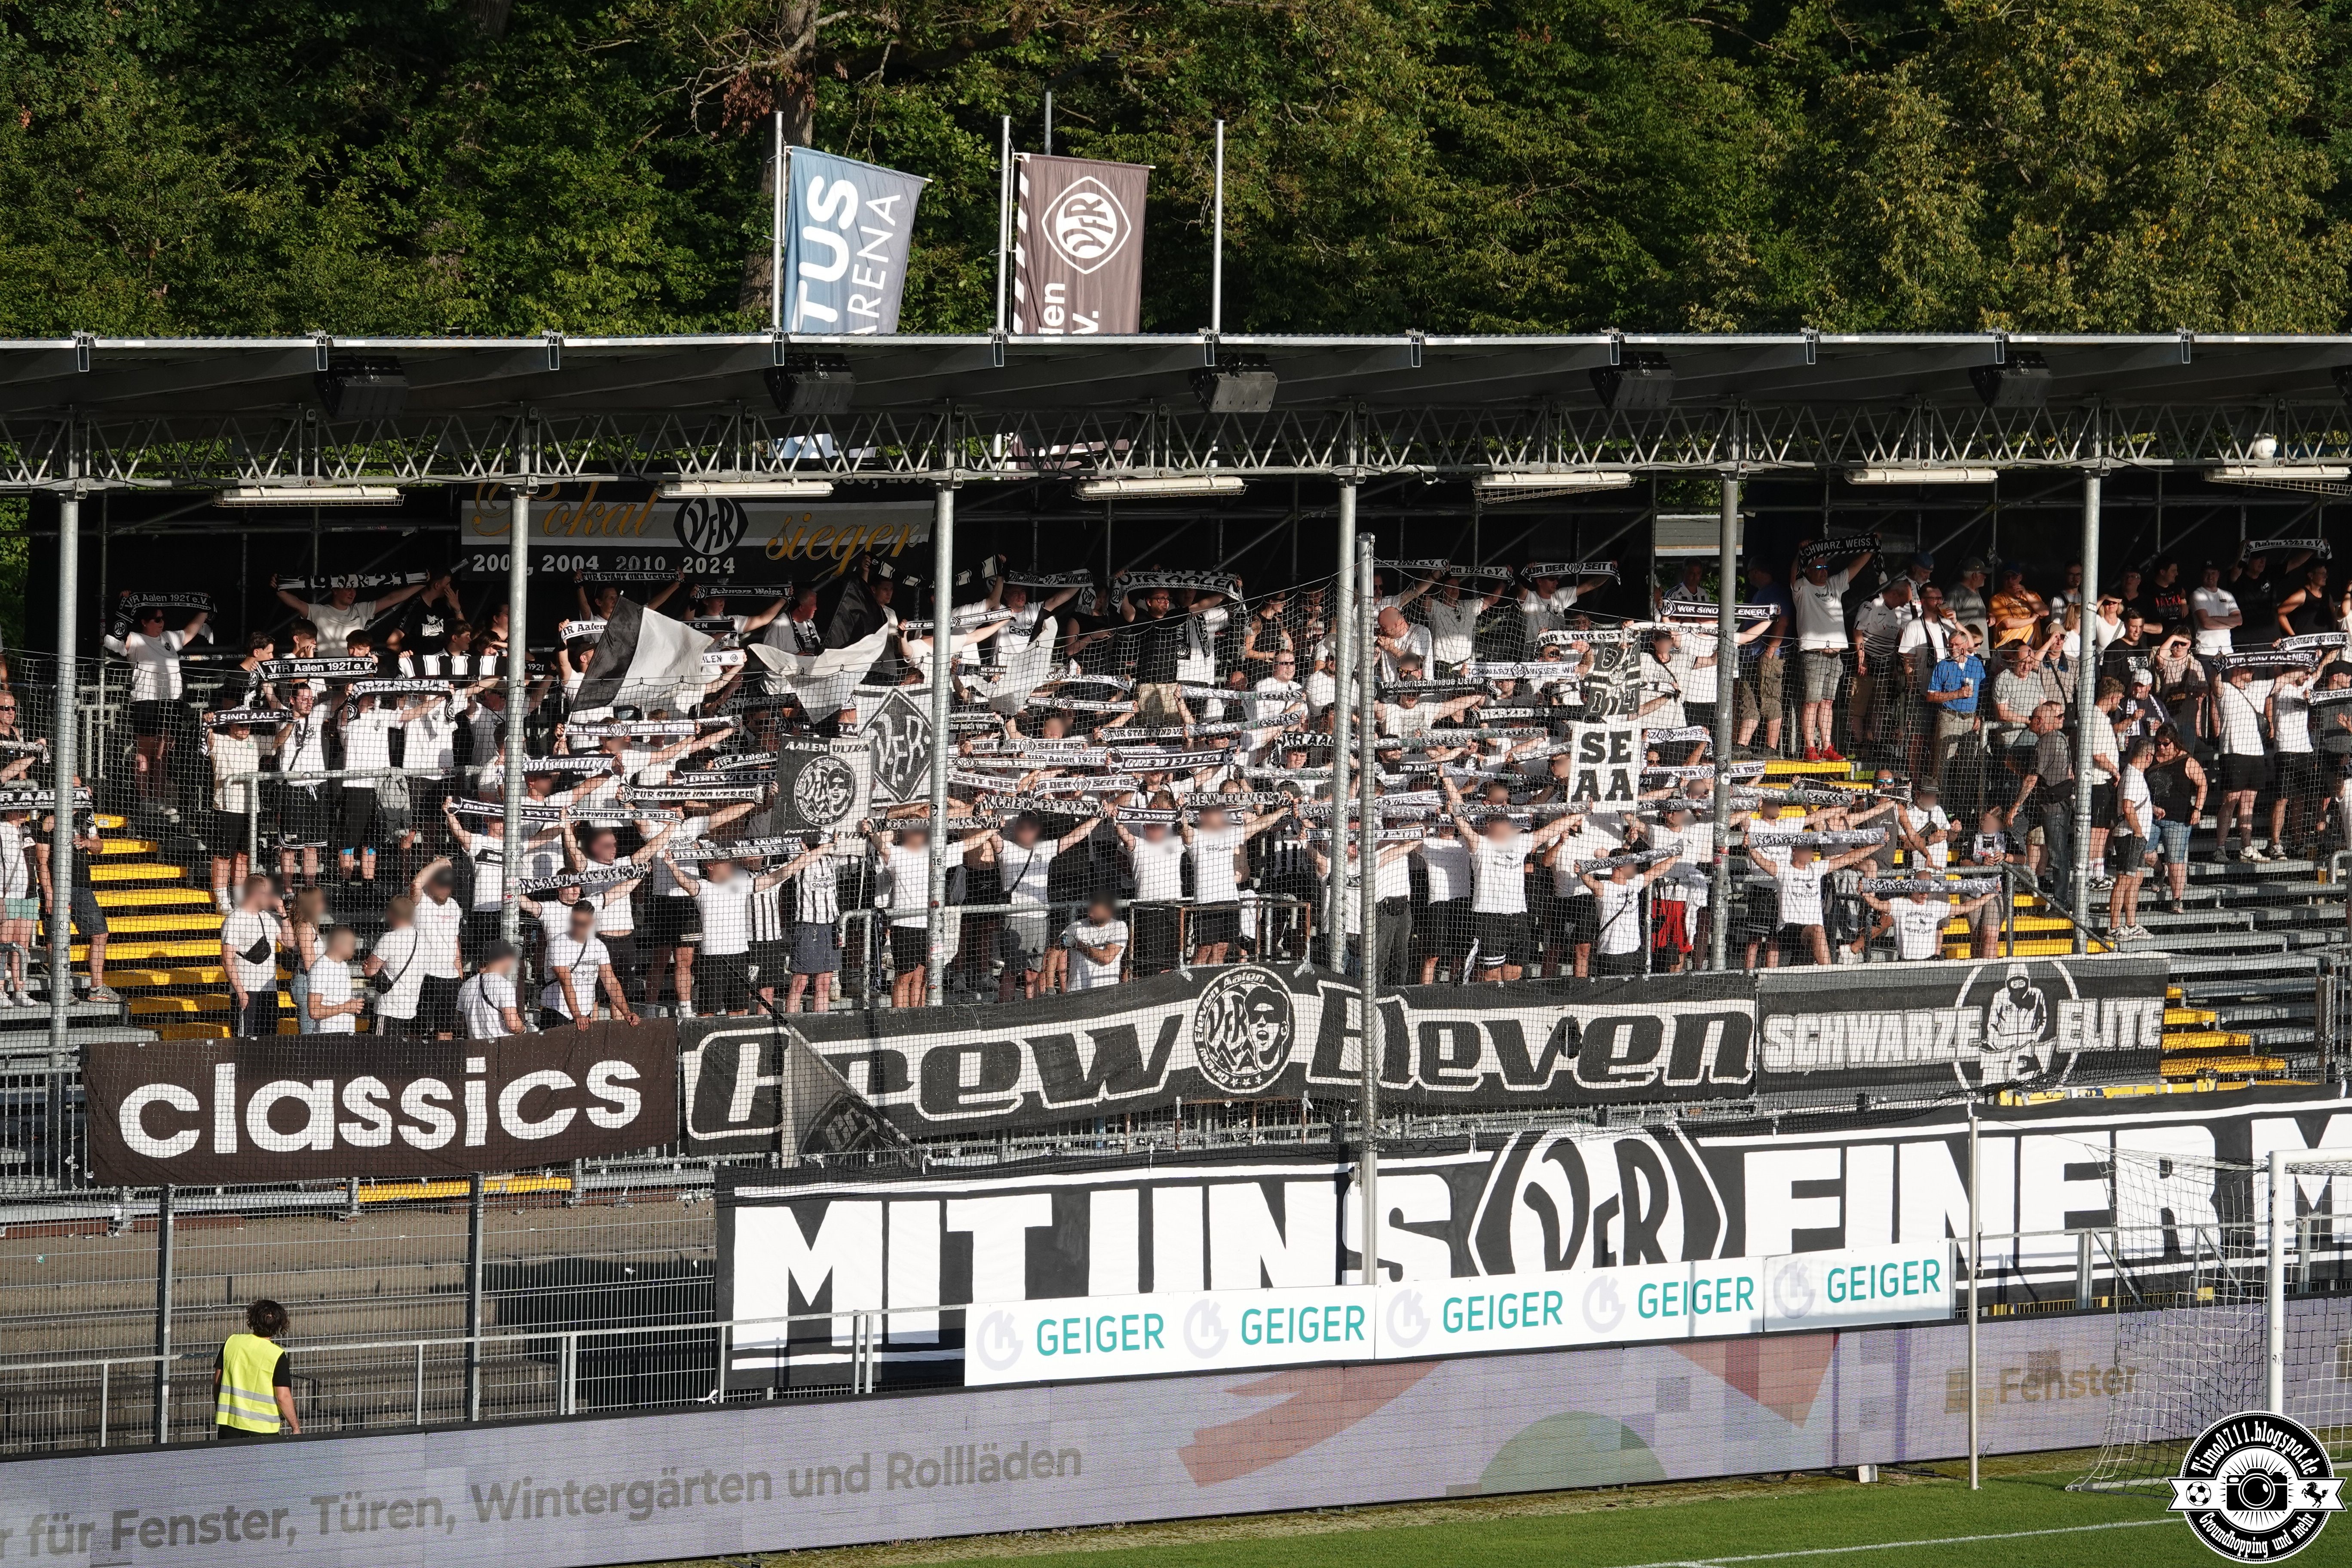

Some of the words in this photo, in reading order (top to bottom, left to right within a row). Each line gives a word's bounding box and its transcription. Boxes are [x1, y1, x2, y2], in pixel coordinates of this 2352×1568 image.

[766, 512, 921, 581] sieger
[473, 554, 533, 575] 200,
[542, 555, 600, 572] 2004
[616, 556, 666, 572] 2010
[683, 557, 735, 574] 2024
[1545, 563, 1566, 573] DER
[1584, 562, 1607, 571] SEIT
[142, 594, 167, 602] Aalen
[1678, 605, 1695, 613] WIR
[1010, 626, 1033, 636] CENTU
[269, 664, 291, 674] VfR
[294, 662, 325, 673] Aalen
[327, 661, 351, 671] 1921
[354, 661, 373, 671] e.V.
[784, 741, 828, 753] AALEN
[1578, 731, 1632, 764] SE
[1571, 769, 1633, 802] AA
[1223, 971, 1266, 988] Aalen
[1763, 1006, 1983, 1073] SCHWARZE
[2057, 997, 2165, 1053] ELITE
[118, 1056, 642, 1158] classics
[1744, 1124, 2221, 1272] EINER
[1037, 1313, 1164, 1357] GEIGER
[1241, 1304, 1366, 1346] GEIGER
[1442, 1290, 1563, 1334] GEIGER
[1637, 1275, 1755, 1320] GEIGER
[1827, 1258, 1941, 1304] GEIGER
[1999, 1363, 2135, 1404] Fenster
[28, 1512, 101, 1557] für
[113, 1504, 297, 1549] Fenster,
[311, 1491, 457, 1535] Türen,
[470, 1467, 772, 1523] Wintergärten
[788, 1452, 870, 1499] und
[885, 1440, 1082, 1490] Rollläden
